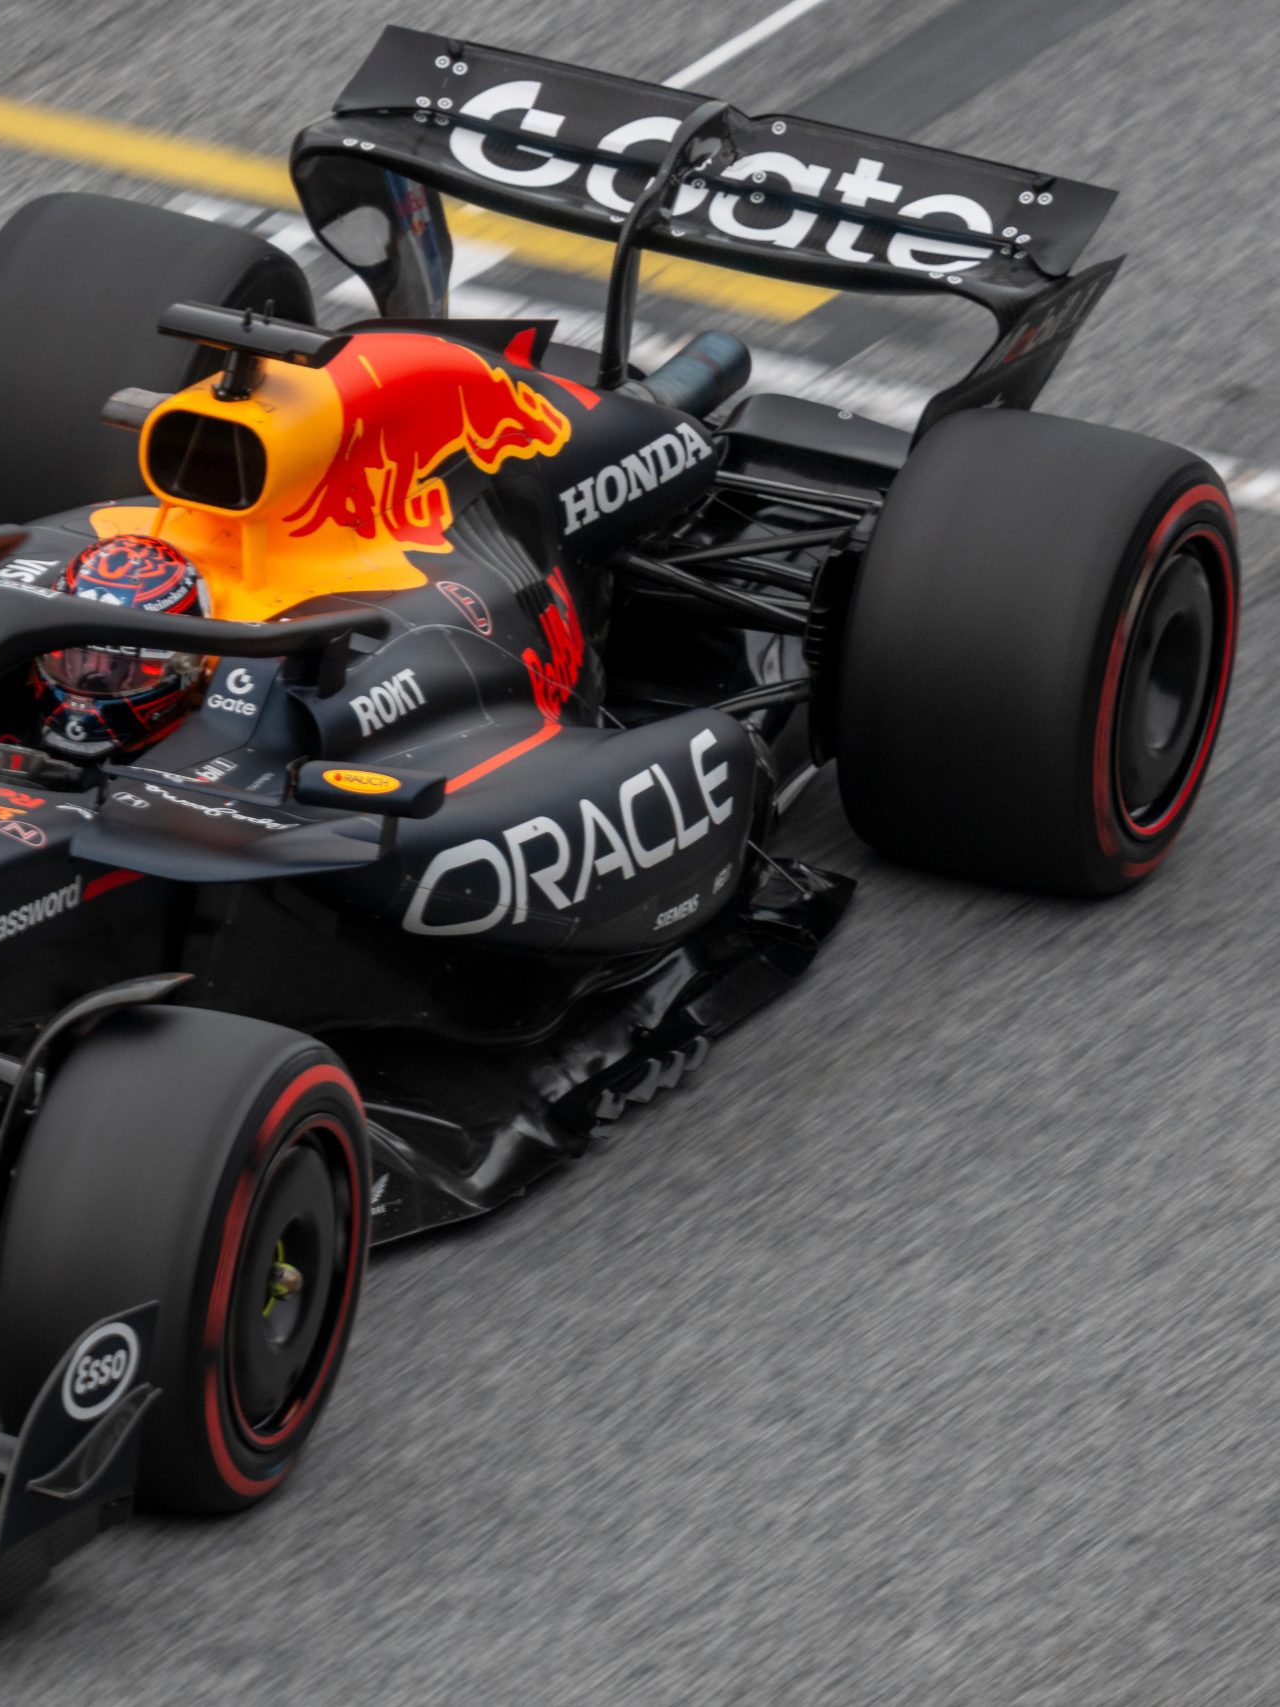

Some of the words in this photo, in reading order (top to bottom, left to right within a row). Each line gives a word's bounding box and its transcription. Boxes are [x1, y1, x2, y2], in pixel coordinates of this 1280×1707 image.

[560, 421, 712, 536] HONDA
[207, 694, 258, 716] Gate
[349, 667, 427, 737] ROKT
[342, 773, 390, 788] RAUCH
[401, 728, 734, 936] ORACLE
